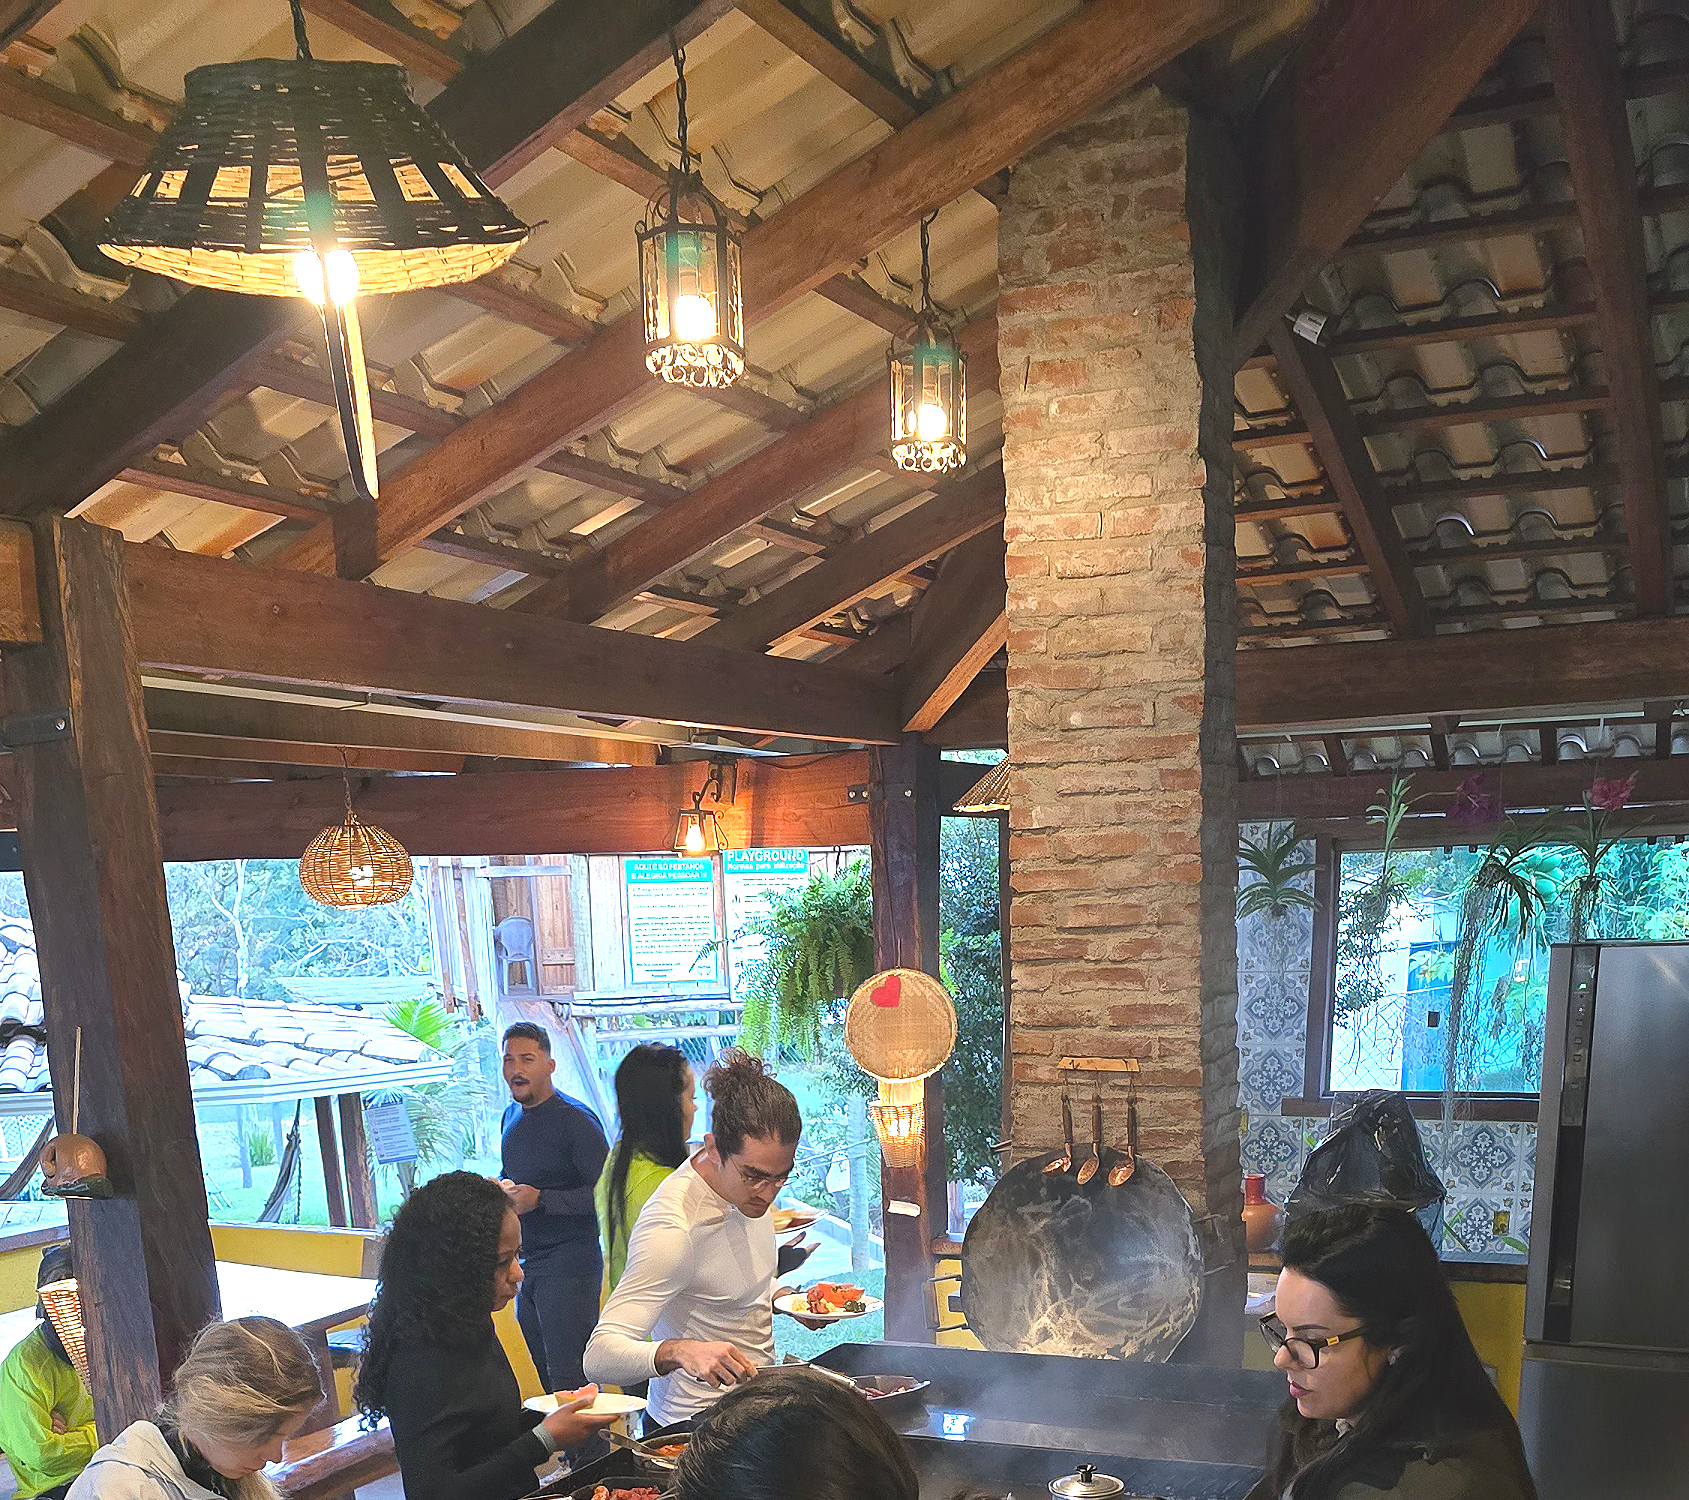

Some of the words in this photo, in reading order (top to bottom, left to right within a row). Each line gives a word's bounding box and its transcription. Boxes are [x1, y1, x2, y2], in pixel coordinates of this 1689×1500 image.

[727, 849, 805, 862] PLAYGROUND
[633, 863, 652, 871] AQUI
[727, 862, 754, 871] Normas
[755, 863, 772, 872] para
[637, 871, 668, 880] ALEGRIA
